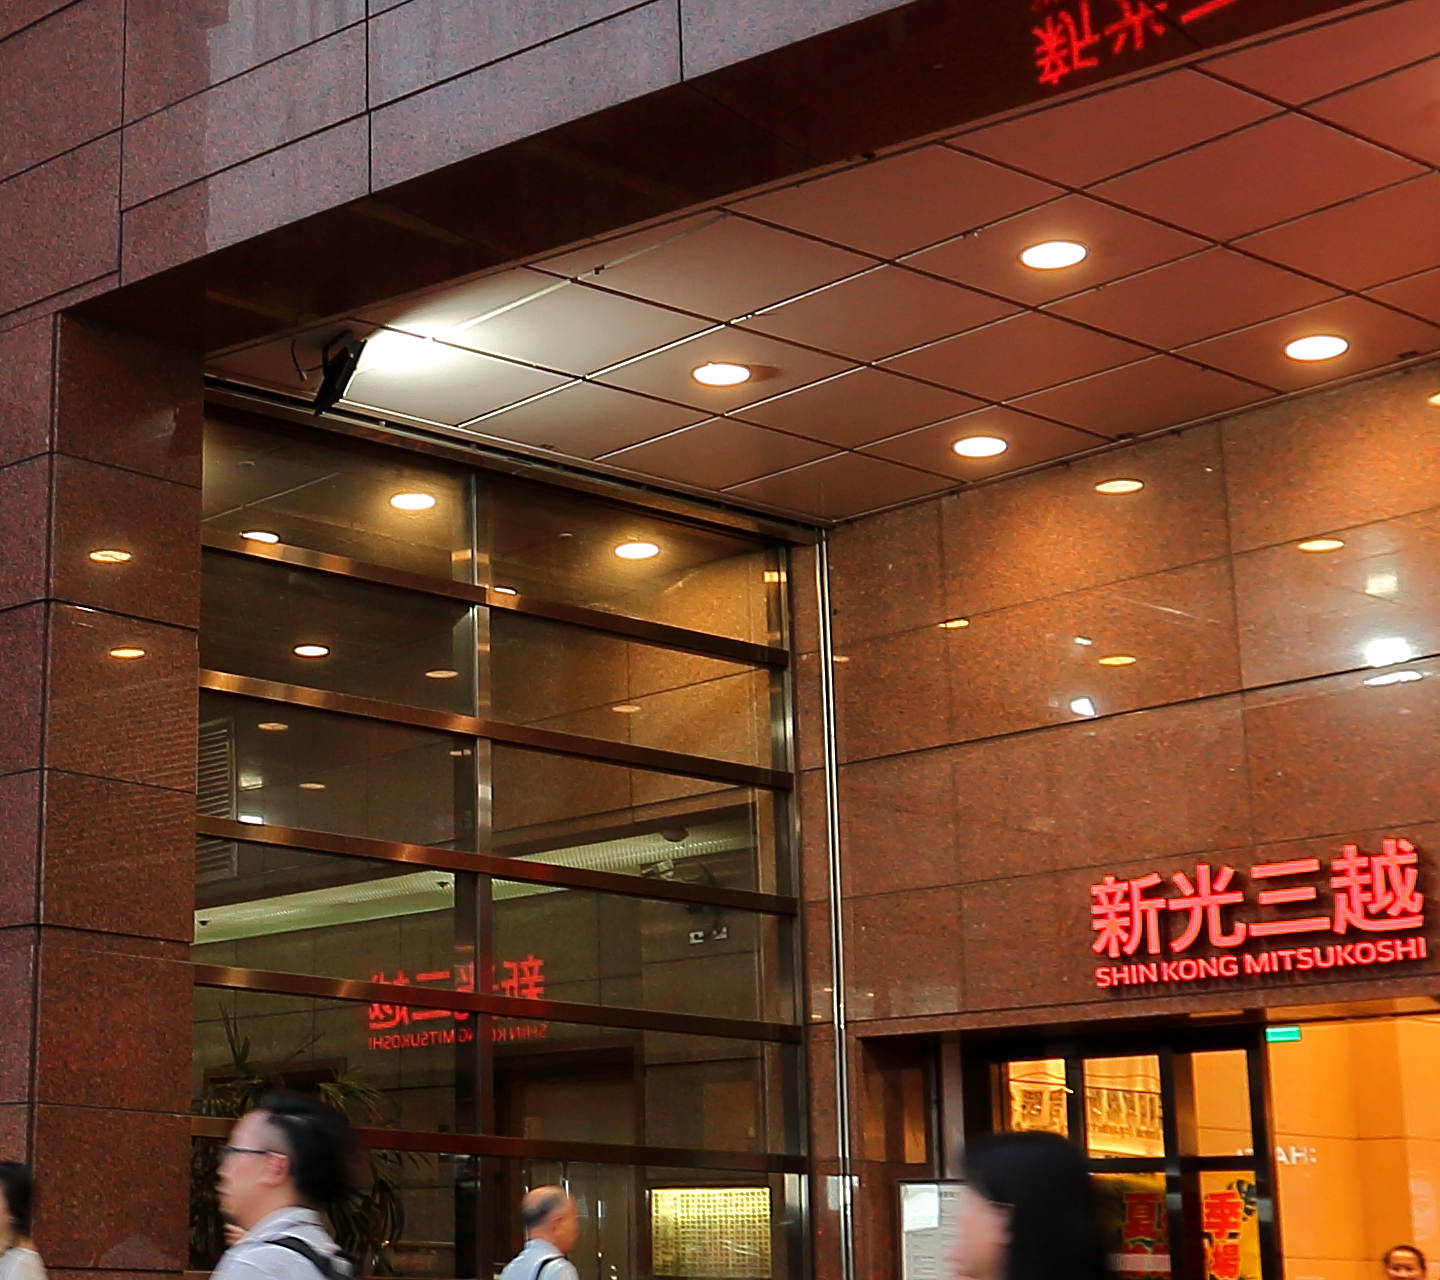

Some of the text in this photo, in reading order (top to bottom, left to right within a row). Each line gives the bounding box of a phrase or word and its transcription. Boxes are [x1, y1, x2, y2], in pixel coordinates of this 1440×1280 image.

[1090, 837, 1425, 959] 新光三越
[1095, 936, 1428, 989] SHIN KONG MITSUKOSHI
